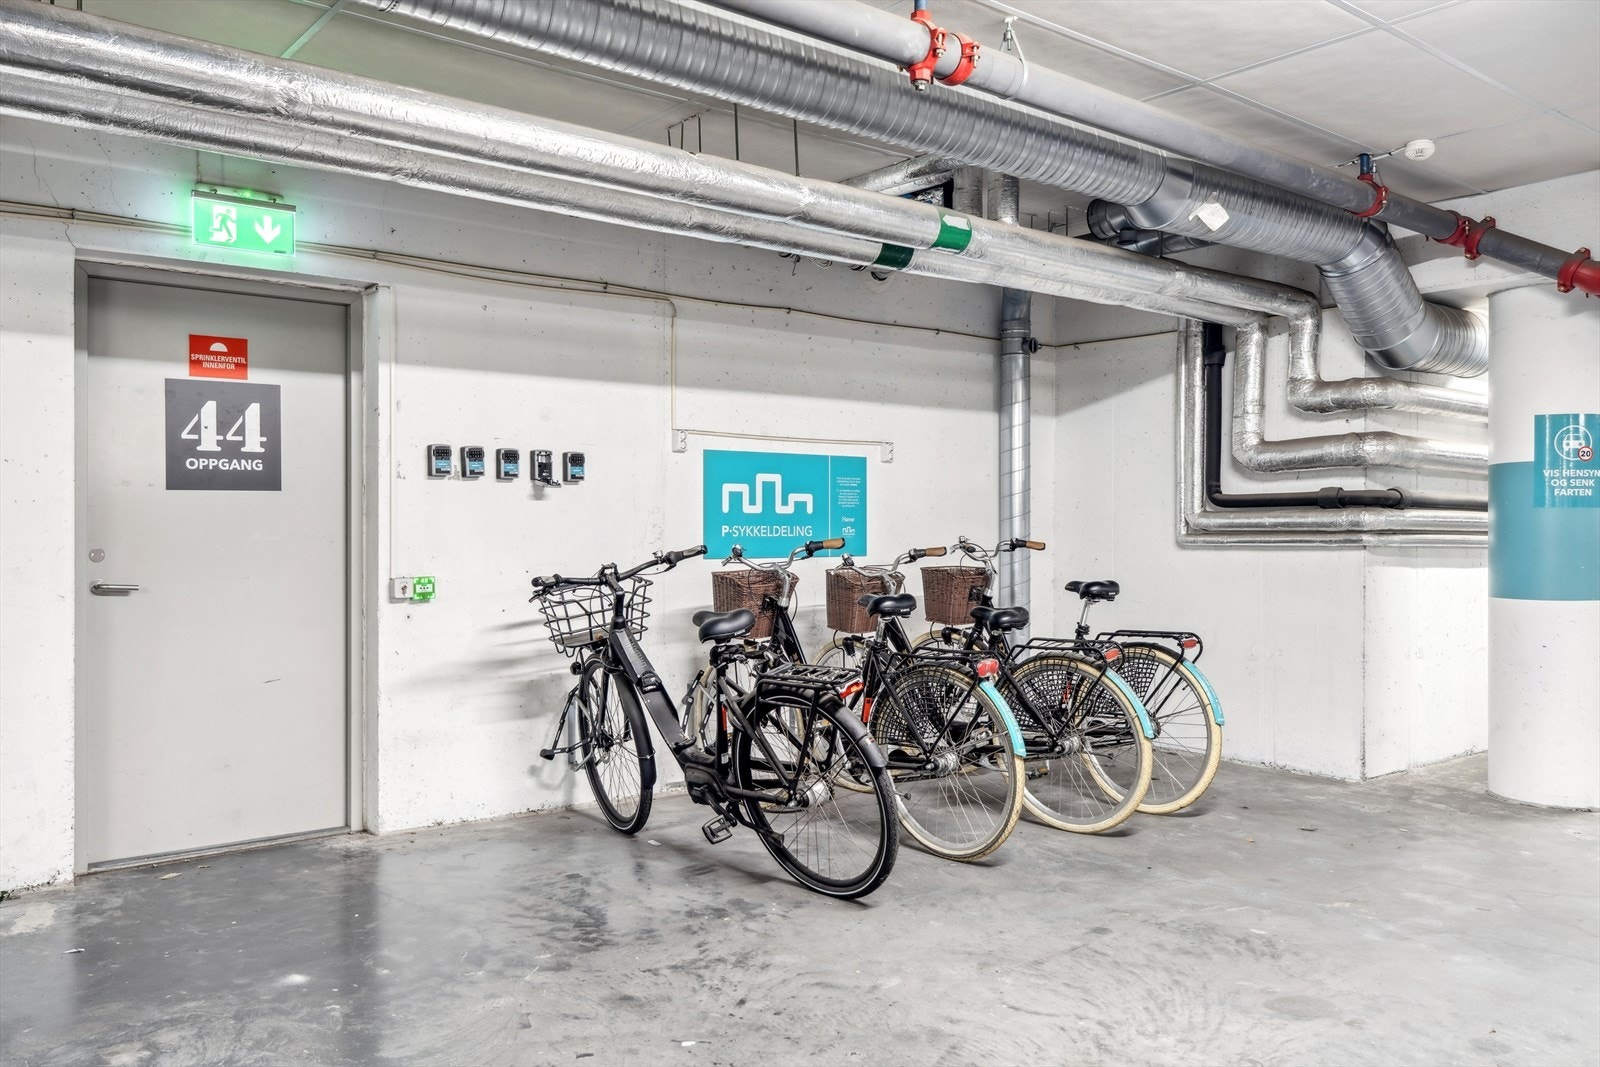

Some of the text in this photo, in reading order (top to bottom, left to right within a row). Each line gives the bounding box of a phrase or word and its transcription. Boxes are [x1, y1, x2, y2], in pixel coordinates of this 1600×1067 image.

[190, 354, 246, 364] SPRINKLERVENTIL
[202, 362, 236, 370] INNENFOR
[181, 400, 267, 453] 44
[185, 458, 263, 471] OPPGANG
[1550, 479, 1595, 487] OG SENK
[1554, 488, 1592, 496] FARTEN
